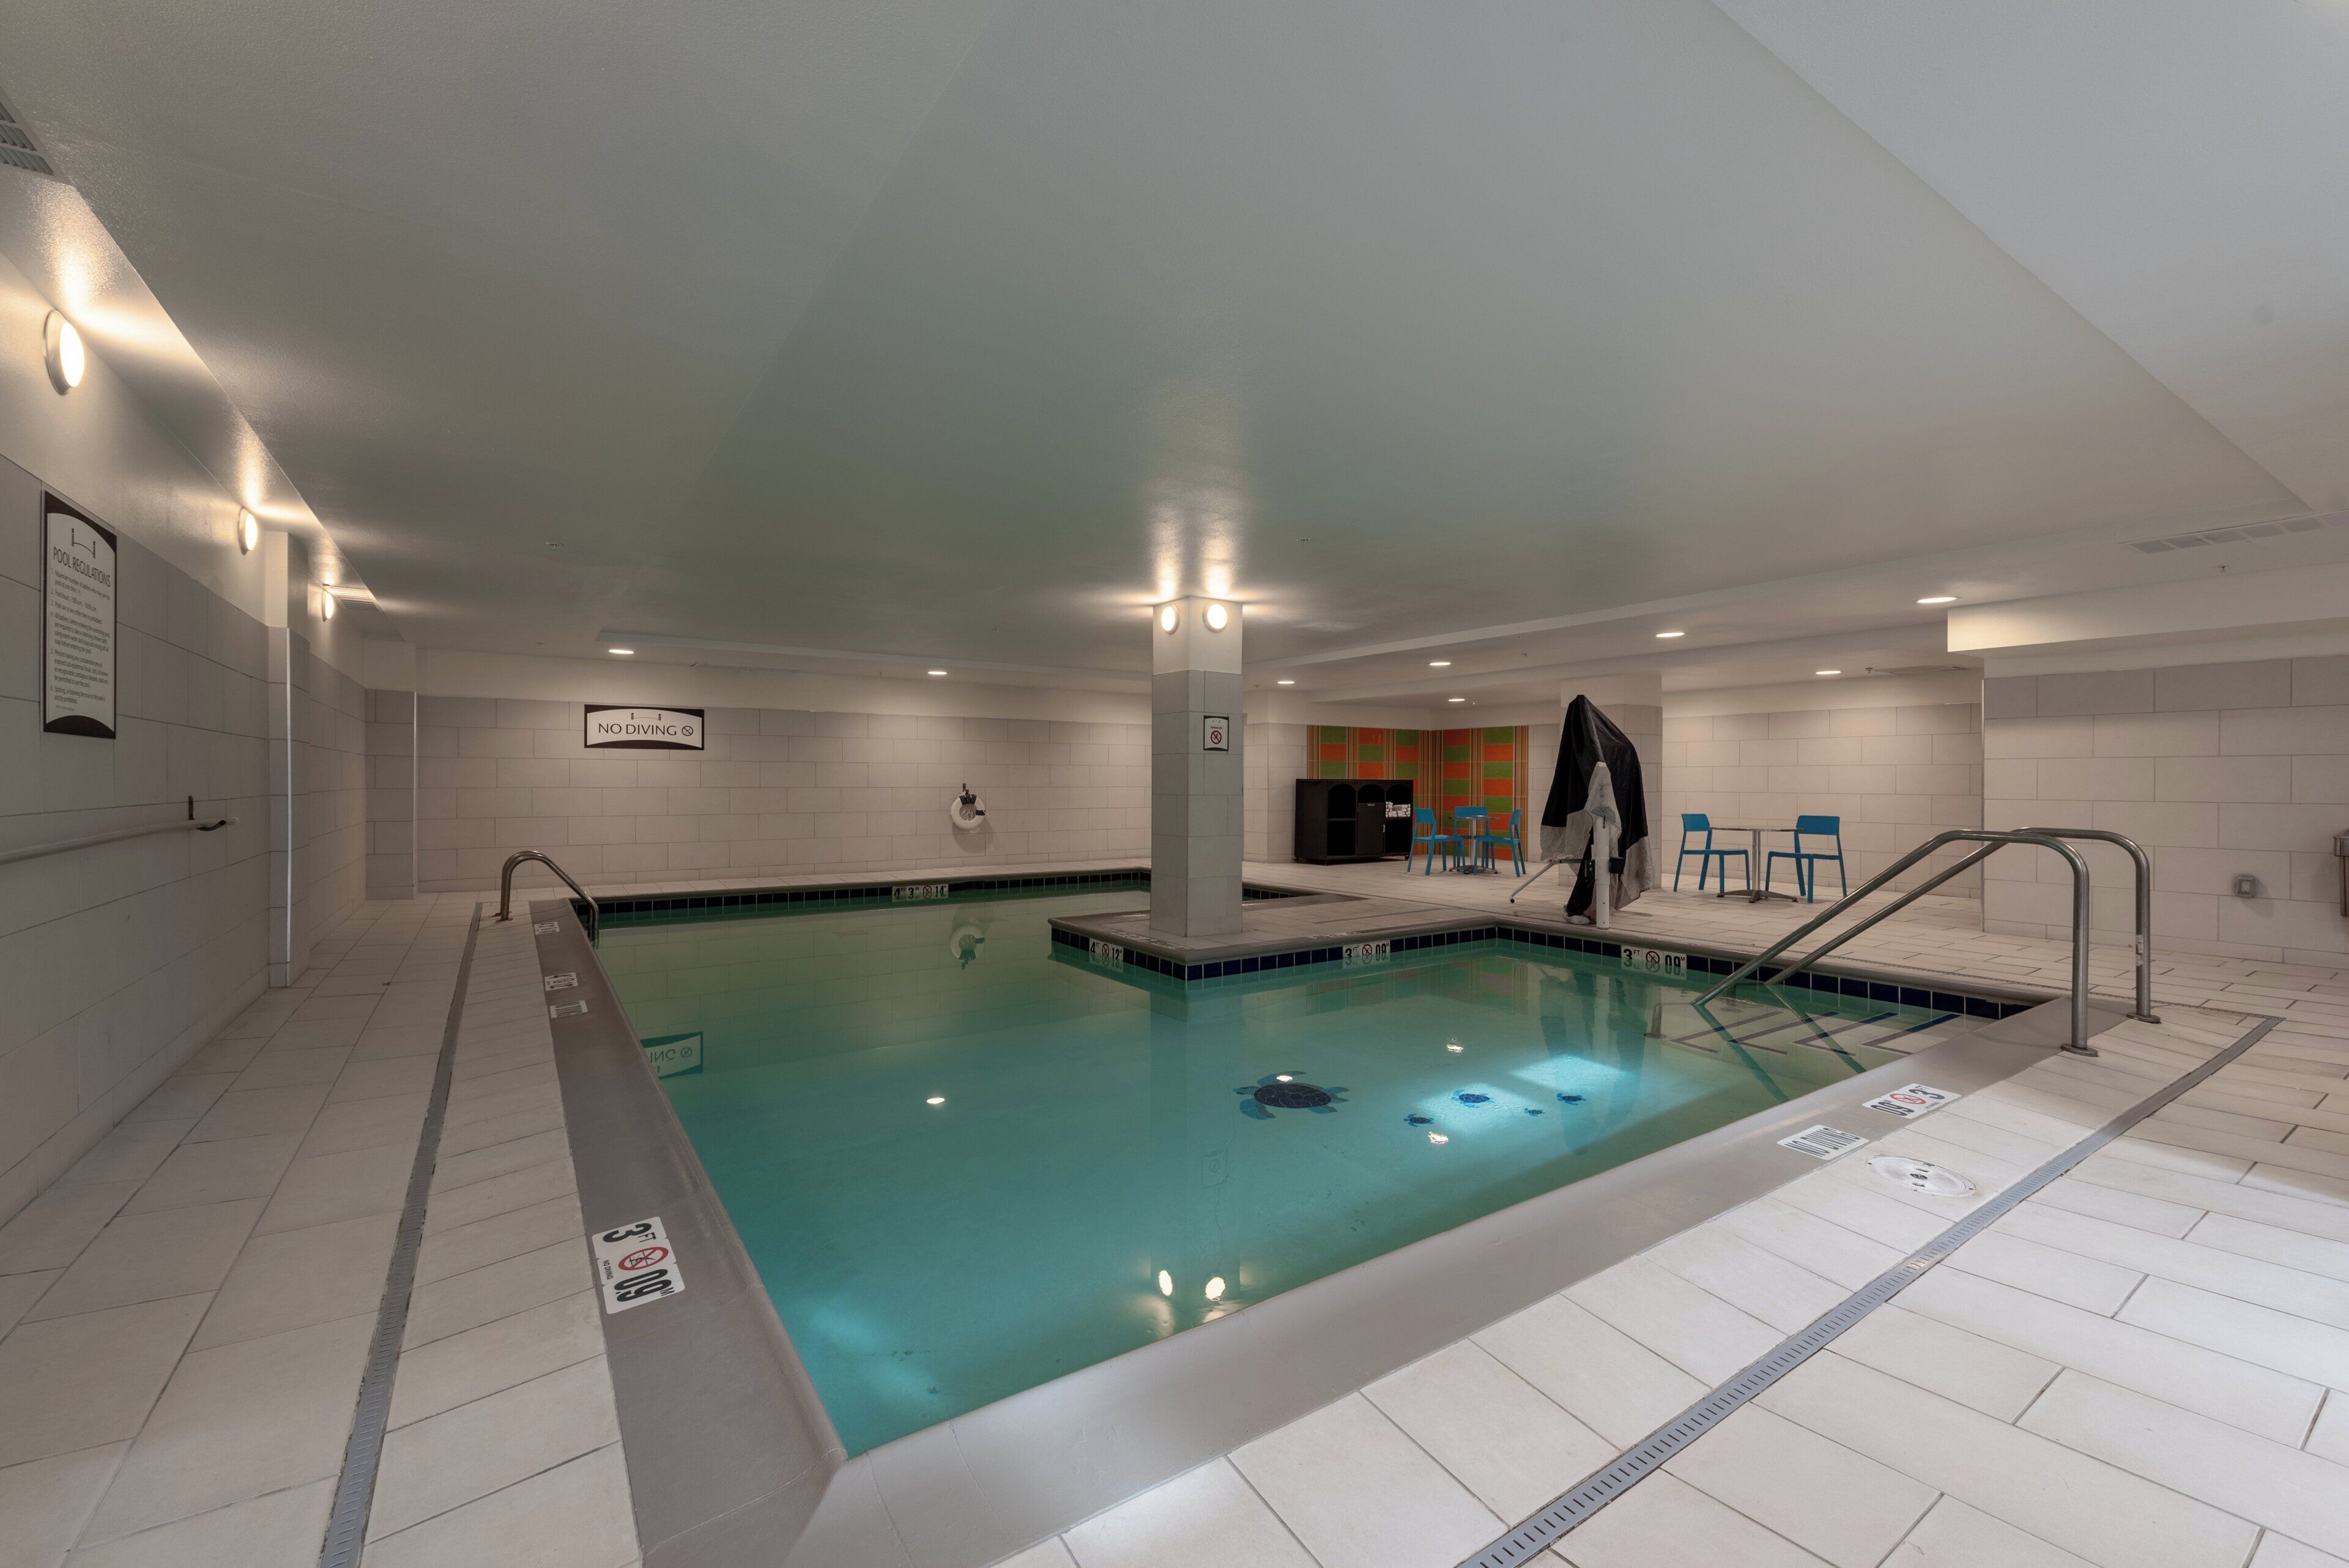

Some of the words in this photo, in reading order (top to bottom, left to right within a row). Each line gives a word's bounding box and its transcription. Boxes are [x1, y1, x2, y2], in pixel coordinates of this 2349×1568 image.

[53, 546, 71, 568] POOL
[73, 557, 110, 587] REGULATIONS
[598, 723, 622, 734] NO
[626, 724, 677, 736] DIVING
[1090, 942, 1096, 953] 4
[1345, 948, 1352, 958] 3
[1624, 949, 1632, 959] 3
[1909, 1088, 1945, 1100] 3
[1800, 1128, 1861, 1150] DIVING
[1784, 1140, 1830, 1157] NO
[603, 1223, 652, 1243] 3
[637, 1232, 656, 1243] FT
[604, 1266, 614, 1280] DIVING
[659, 1287, 675, 1296] M
